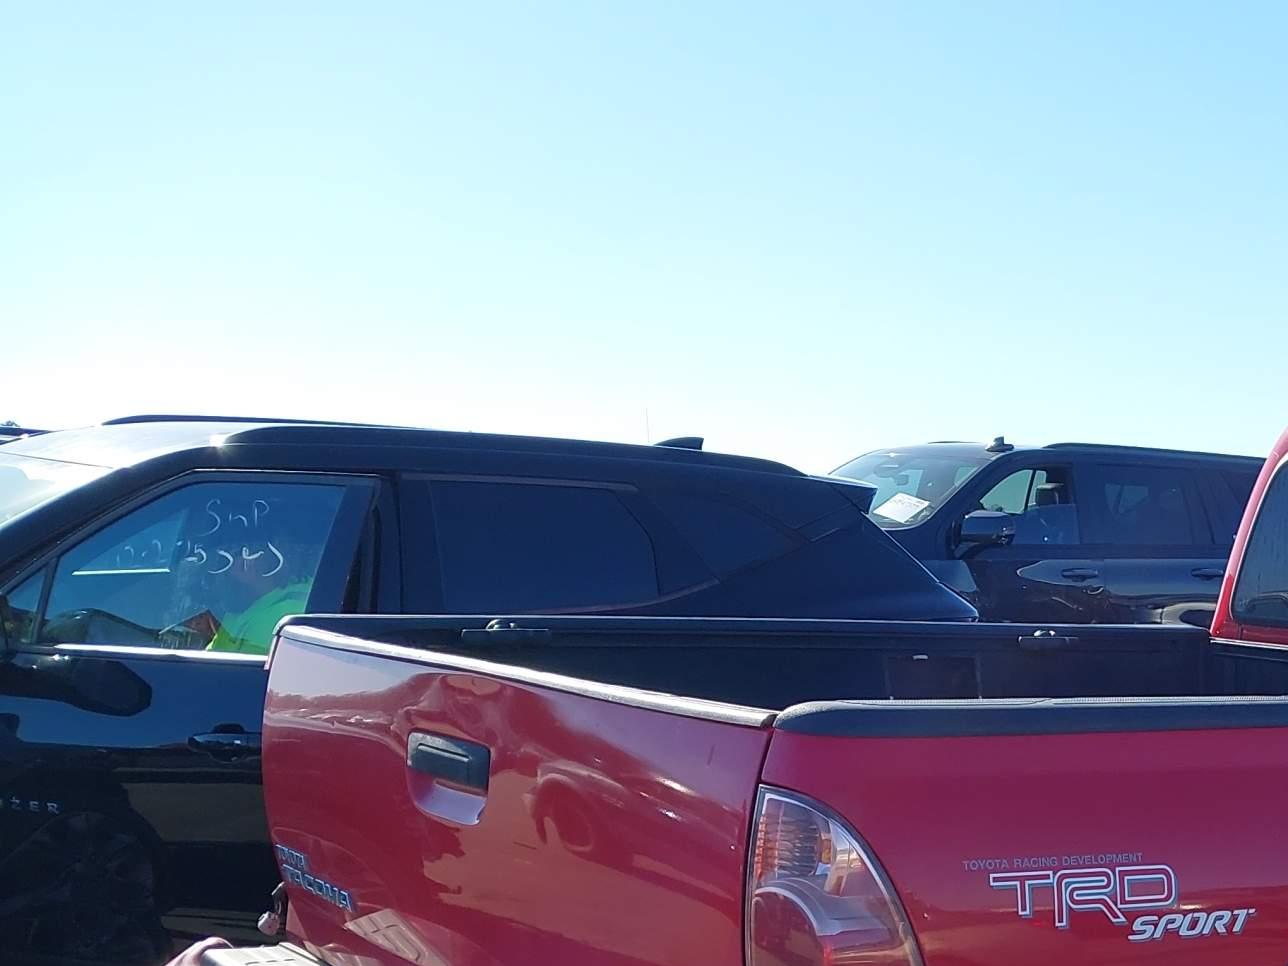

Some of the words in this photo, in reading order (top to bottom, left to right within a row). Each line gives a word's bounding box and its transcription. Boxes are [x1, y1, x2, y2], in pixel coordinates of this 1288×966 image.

[962, 859, 1009, 871] TOYOTA
[1013, 856, 1058, 868] RACING
[1062, 852, 1143, 866] DEVELOPMENT
[989, 864, 1178, 929] TRD
[1127, 908, 1257, 942] SPORT
